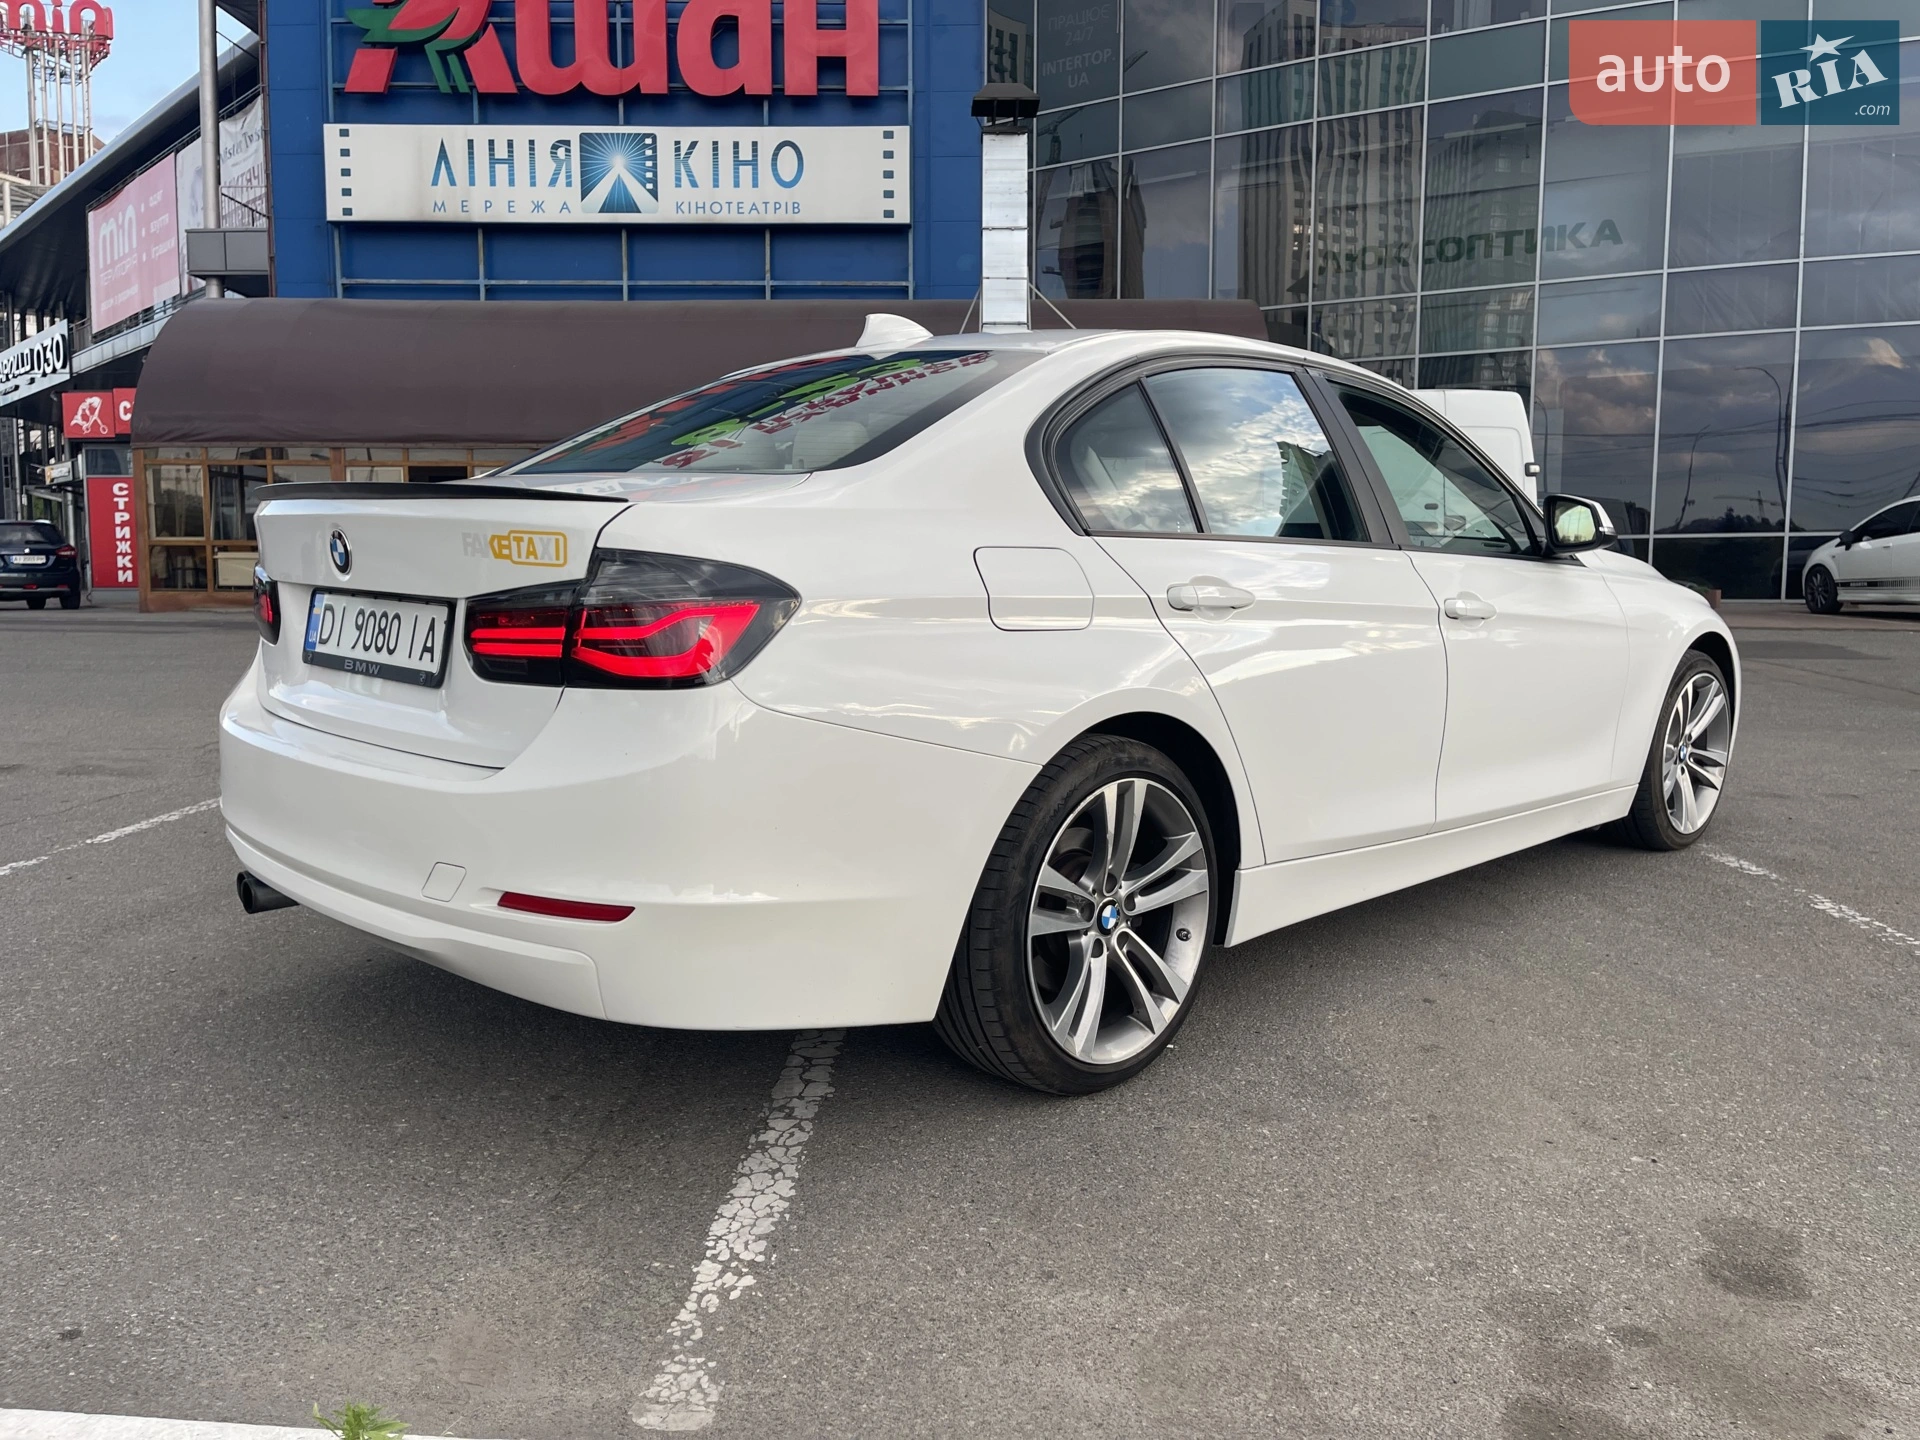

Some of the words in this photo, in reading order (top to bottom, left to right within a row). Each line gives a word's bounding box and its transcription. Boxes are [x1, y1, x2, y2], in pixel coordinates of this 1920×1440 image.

[1064, 26, 1094, 47] 24/7
[431, 138, 573, 188] ЛІНІЯ
[673, 139, 805, 189] КІНО
[432, 200, 572, 214] МЕРЕЖА
[675, 200, 802, 215] КІНОТЕАТРІВ
[99, 204, 137, 269] min
[112, 482, 133, 583] СТРИЖКИ
[308, 630, 317, 643] UA
[318, 603, 347, 647] DI
[351, 607, 402, 655] 9080
[408, 614, 437, 663] IA
[343, 659, 380, 675] BMW
